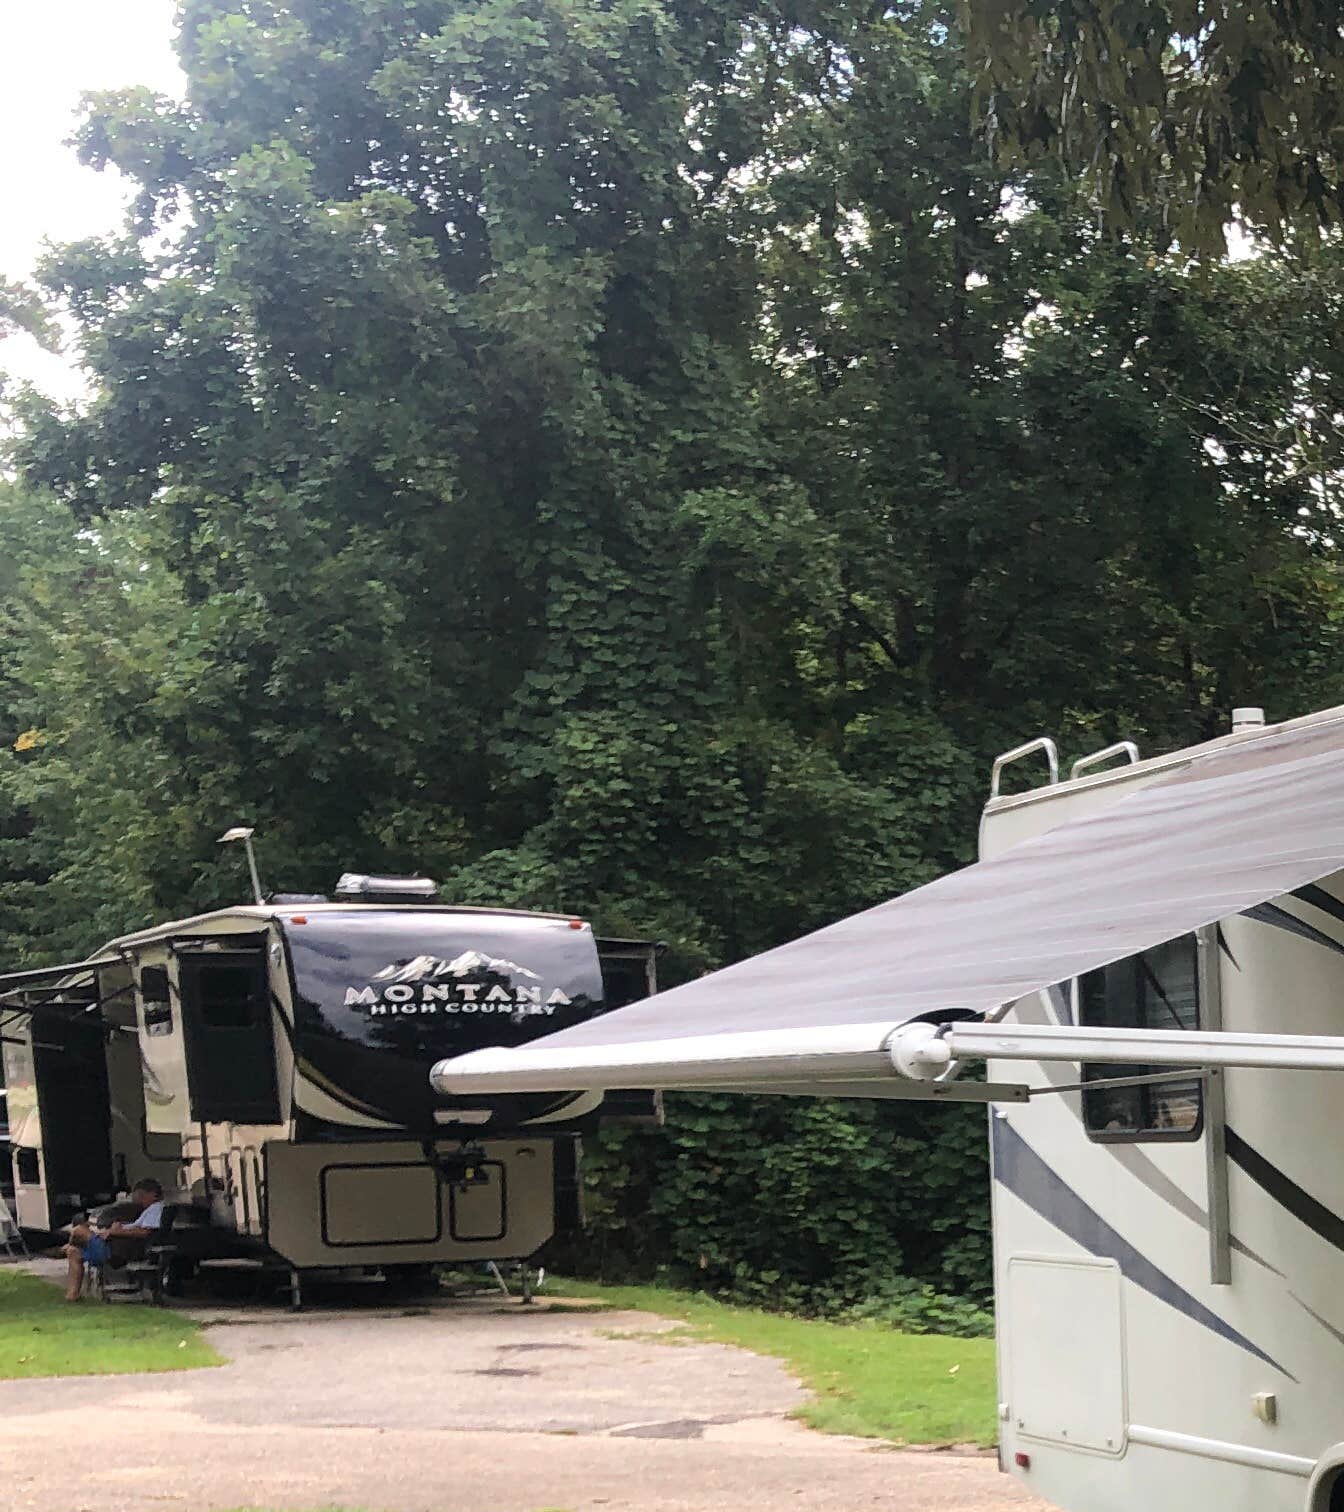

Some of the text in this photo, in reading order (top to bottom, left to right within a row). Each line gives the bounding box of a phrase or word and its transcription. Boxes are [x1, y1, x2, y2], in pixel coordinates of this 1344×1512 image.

[343, 983, 574, 1006] MONTANA
[370, 1002, 557, 1016] HIGH COUNTRY
